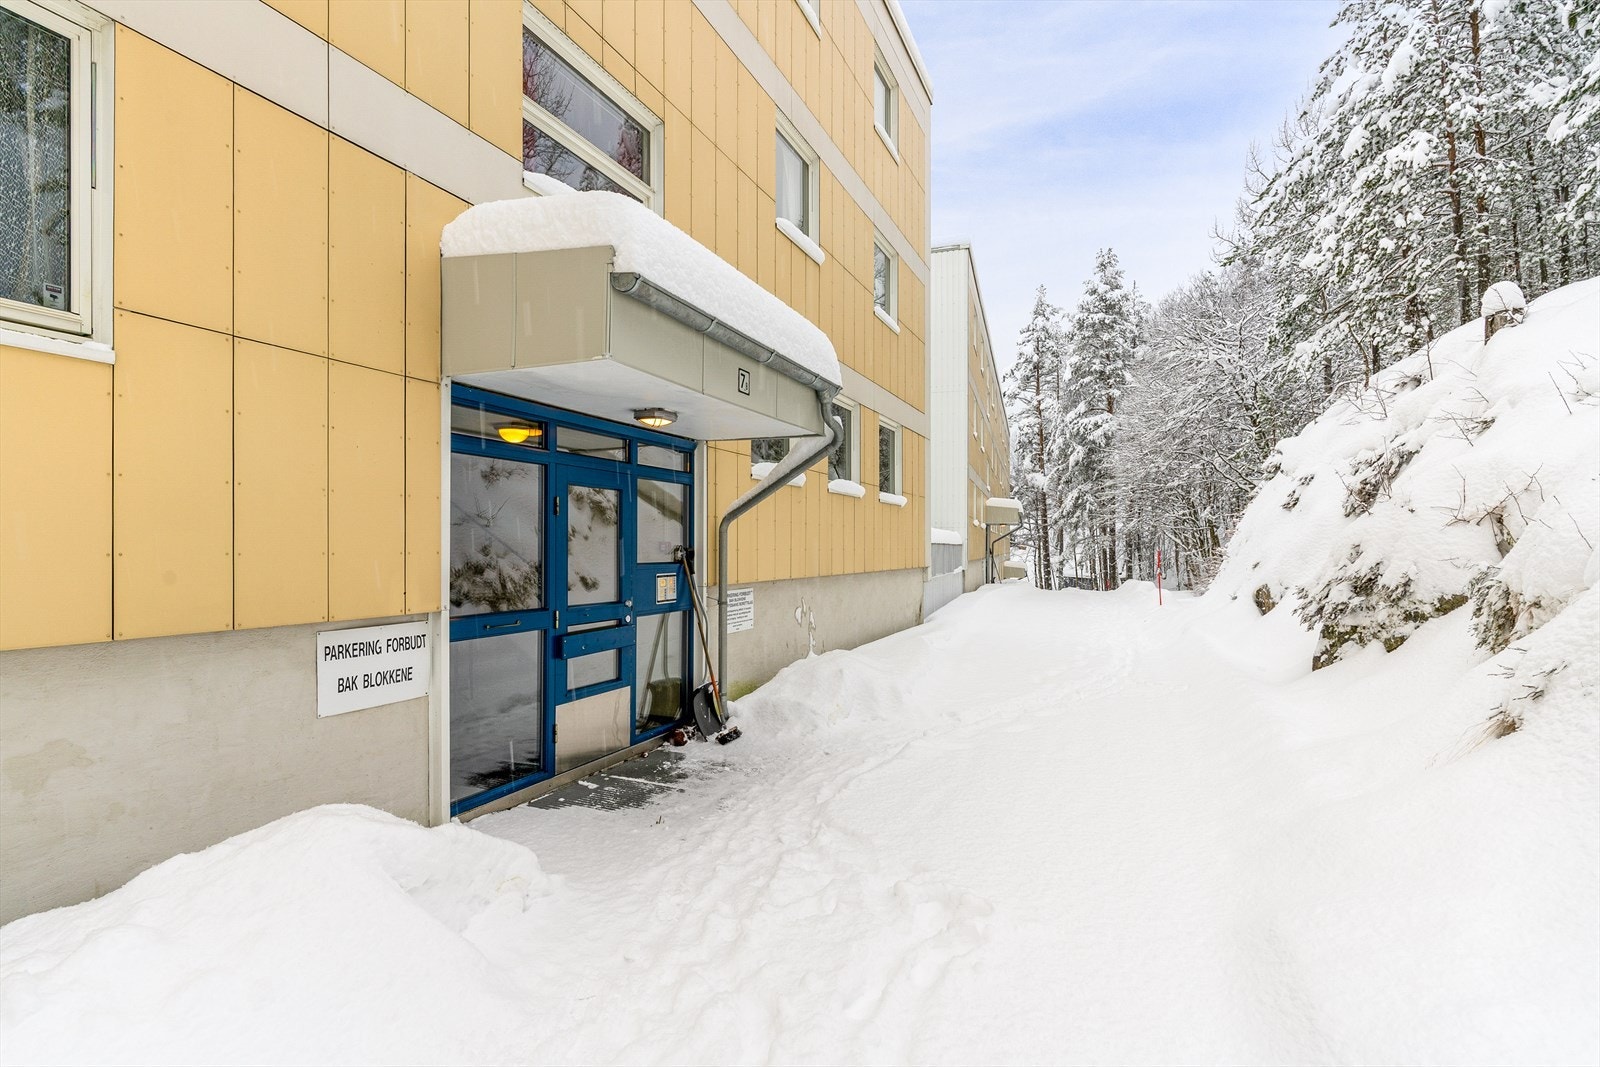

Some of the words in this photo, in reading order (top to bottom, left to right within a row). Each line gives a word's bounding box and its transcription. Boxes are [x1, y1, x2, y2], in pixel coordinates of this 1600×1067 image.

[324, 639, 382, 661] PARKERING
[386, 634, 426, 653] FORBUDT
[337, 675, 358, 693] BAK
[363, 666, 413, 689] BLOKKENE
